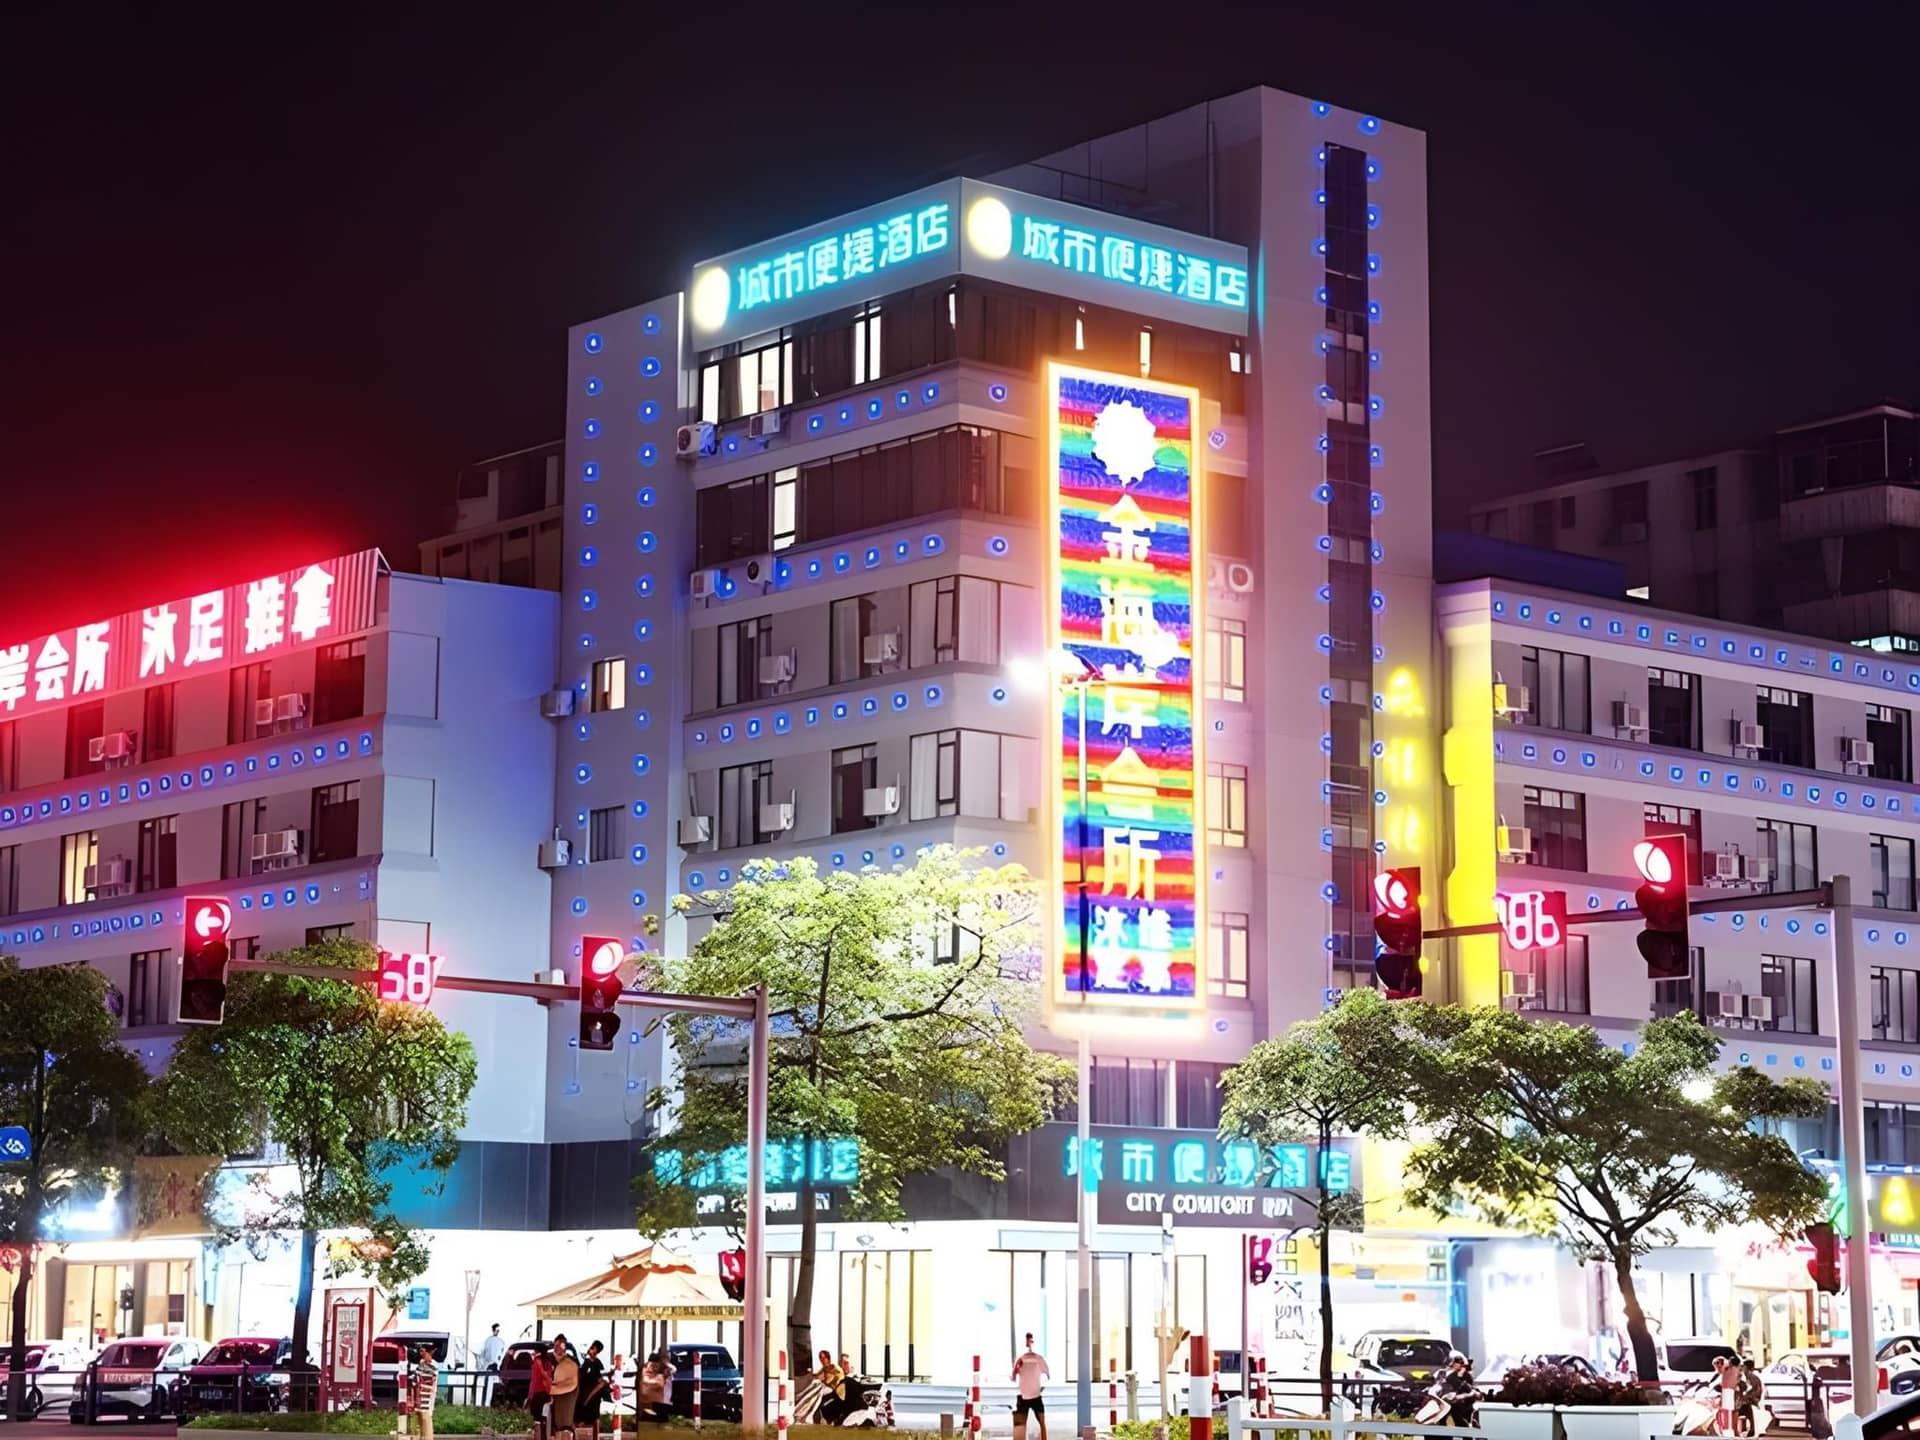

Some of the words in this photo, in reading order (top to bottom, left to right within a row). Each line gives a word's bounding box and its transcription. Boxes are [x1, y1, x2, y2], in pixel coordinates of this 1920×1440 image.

[737, 203, 950, 310] 城市便捷酒店
[1022, 217, 1248, 309] 城市便捷酒店
[1126, 1192, 1166, 1213] CITY
